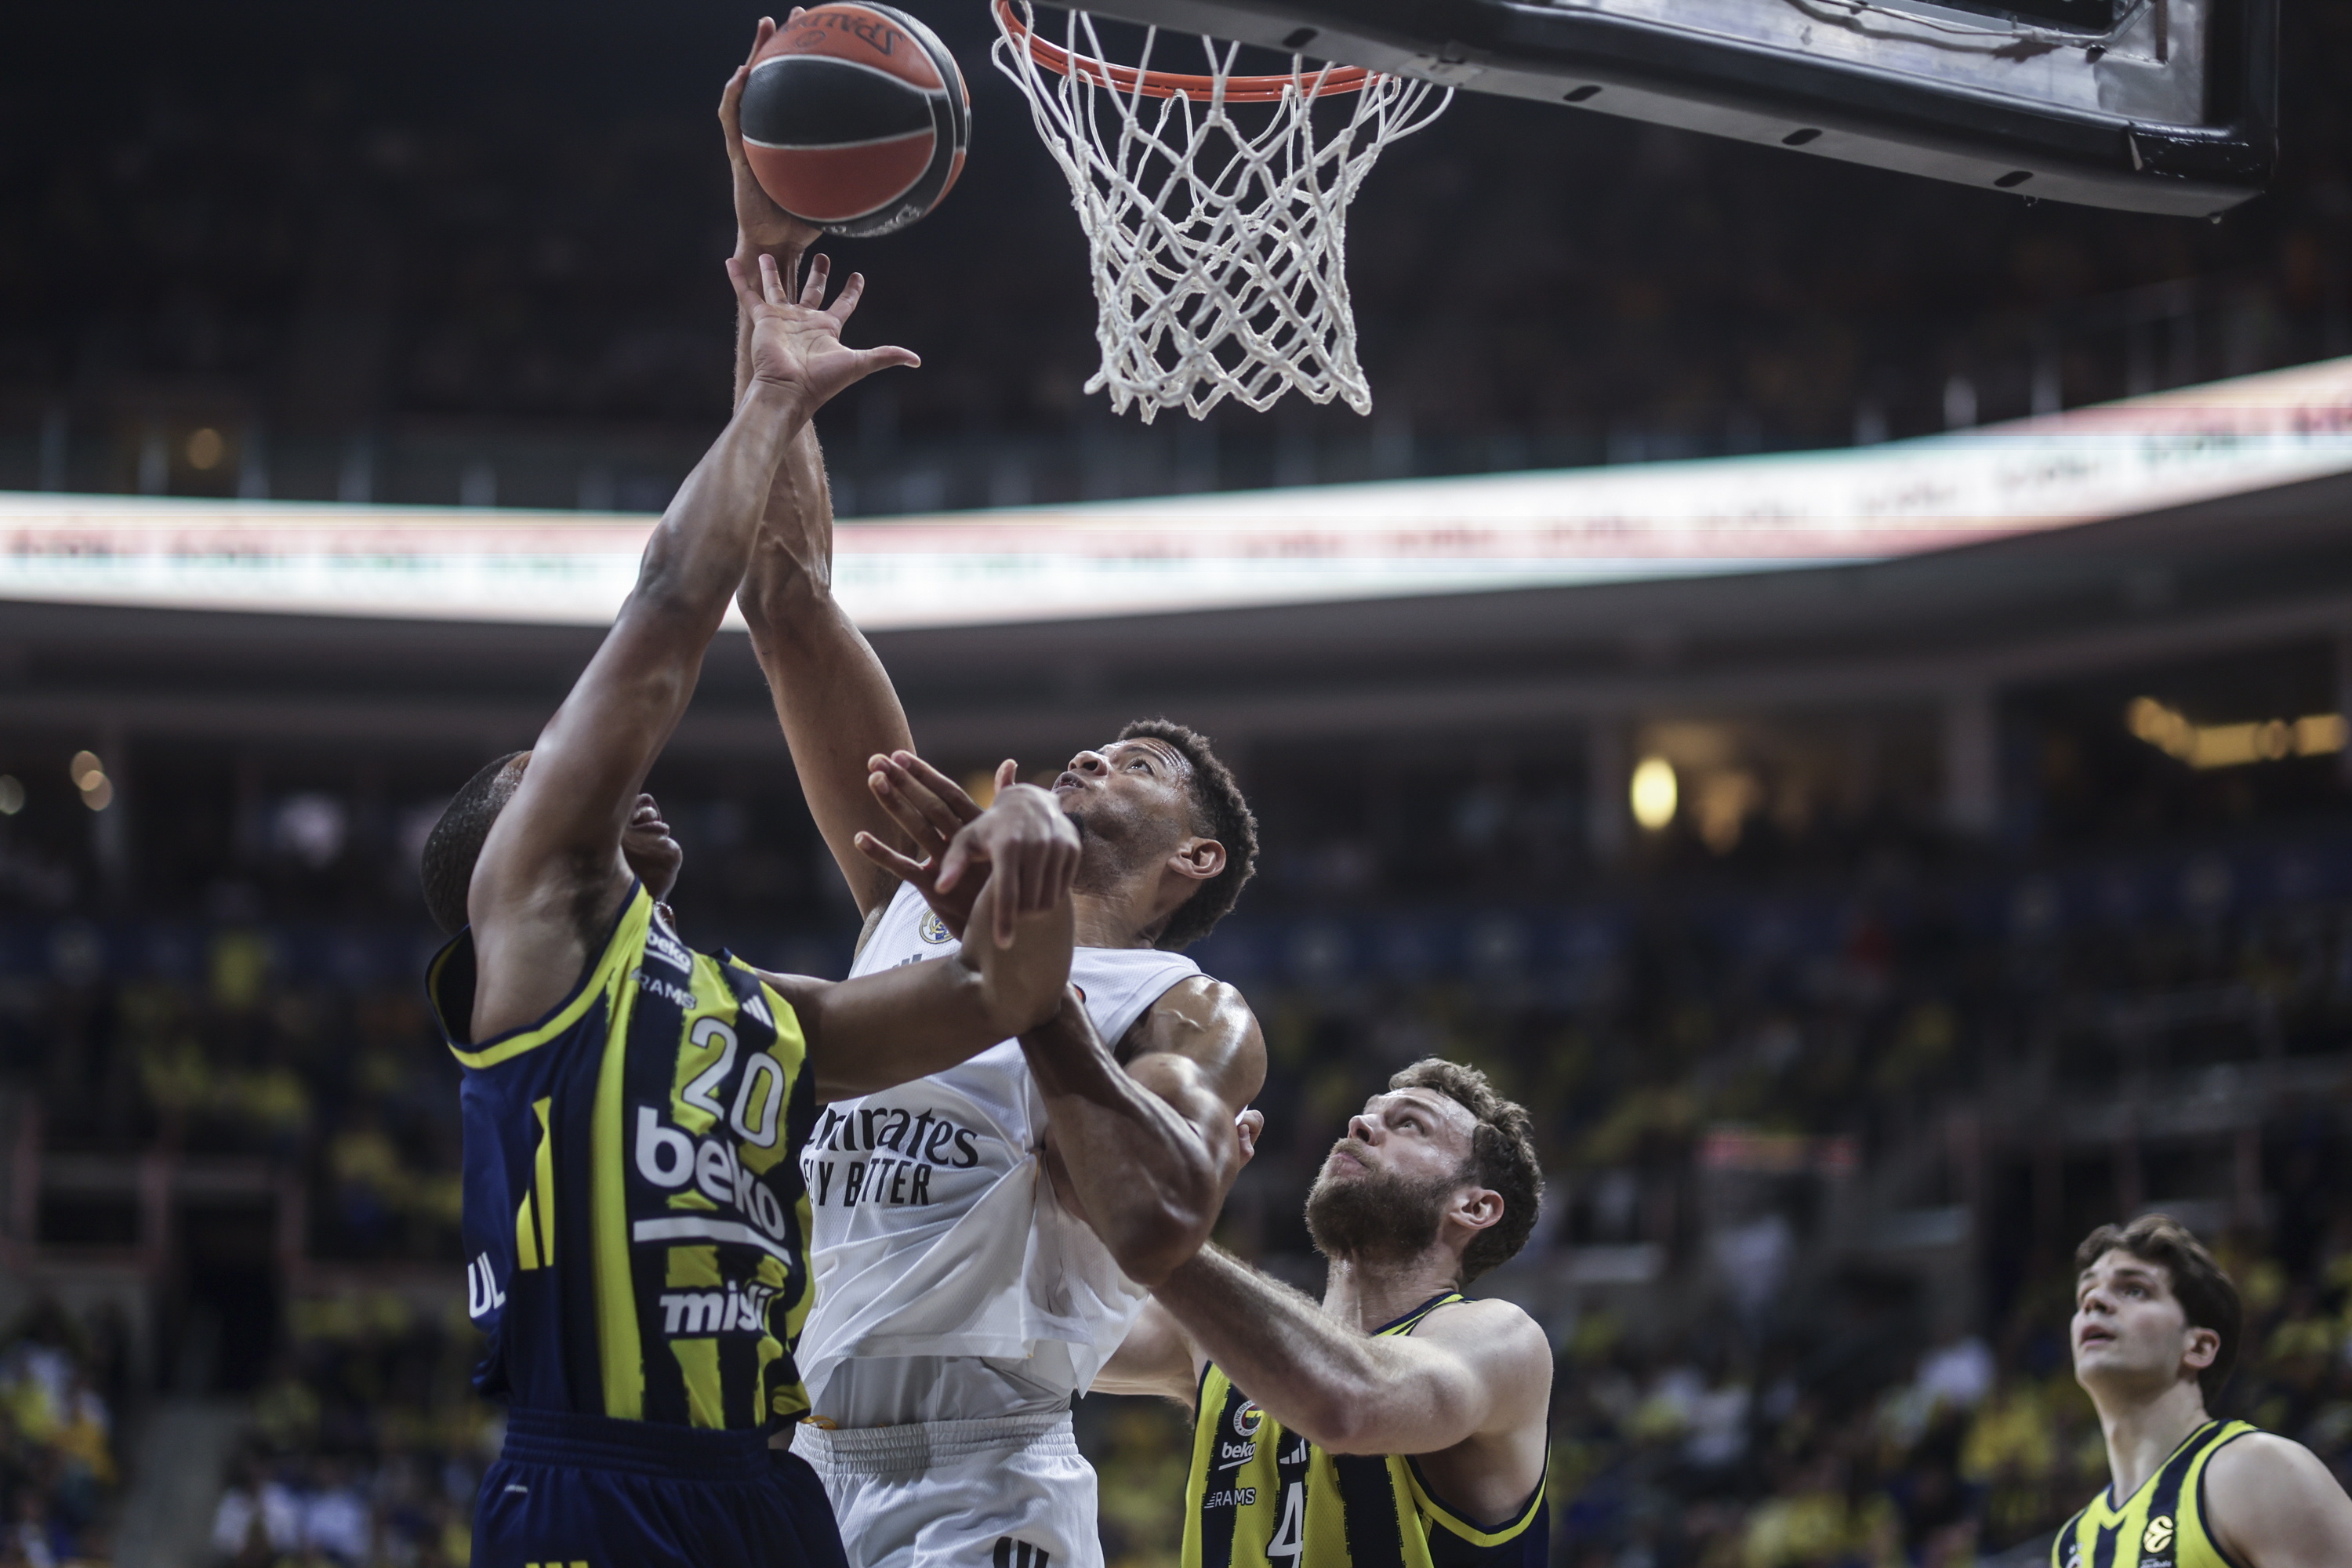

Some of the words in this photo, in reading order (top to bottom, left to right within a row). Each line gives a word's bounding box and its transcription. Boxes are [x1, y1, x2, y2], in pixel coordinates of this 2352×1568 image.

[646, 927, 691, 968] beko
[637, 973, 697, 1011] RAMS
[682, 1017, 785, 1149] 20
[635, 1105, 786, 1241] beko
[1221, 1441, 1256, 1459] beko
[1214, 1488, 1255, 1508] RAMS
[1268, 1481, 1304, 1568] 4
